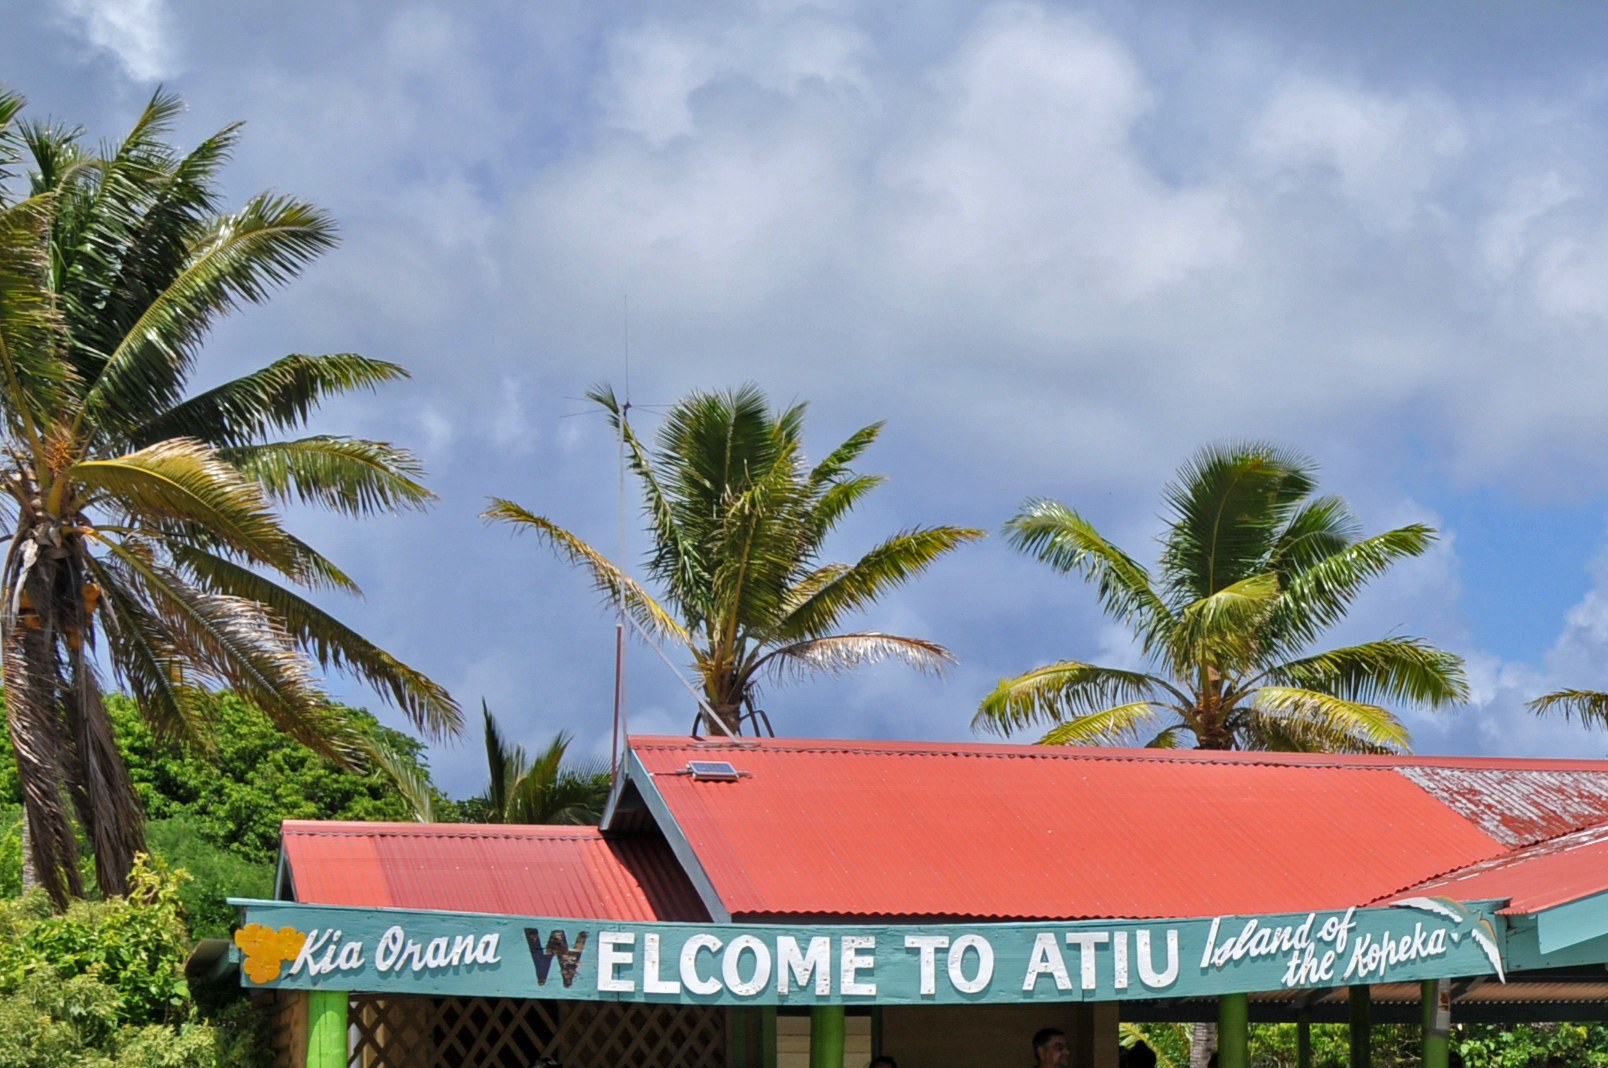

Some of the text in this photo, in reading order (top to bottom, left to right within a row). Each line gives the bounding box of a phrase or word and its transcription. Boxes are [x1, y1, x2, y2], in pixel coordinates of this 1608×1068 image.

[286, 925, 502, 977] Kia Orana
[523, 927, 1179, 997] WELCOME TO ATIU
[1200, 905, 1357, 968] Island of
[1281, 921, 1447, 988] the Kopeka
